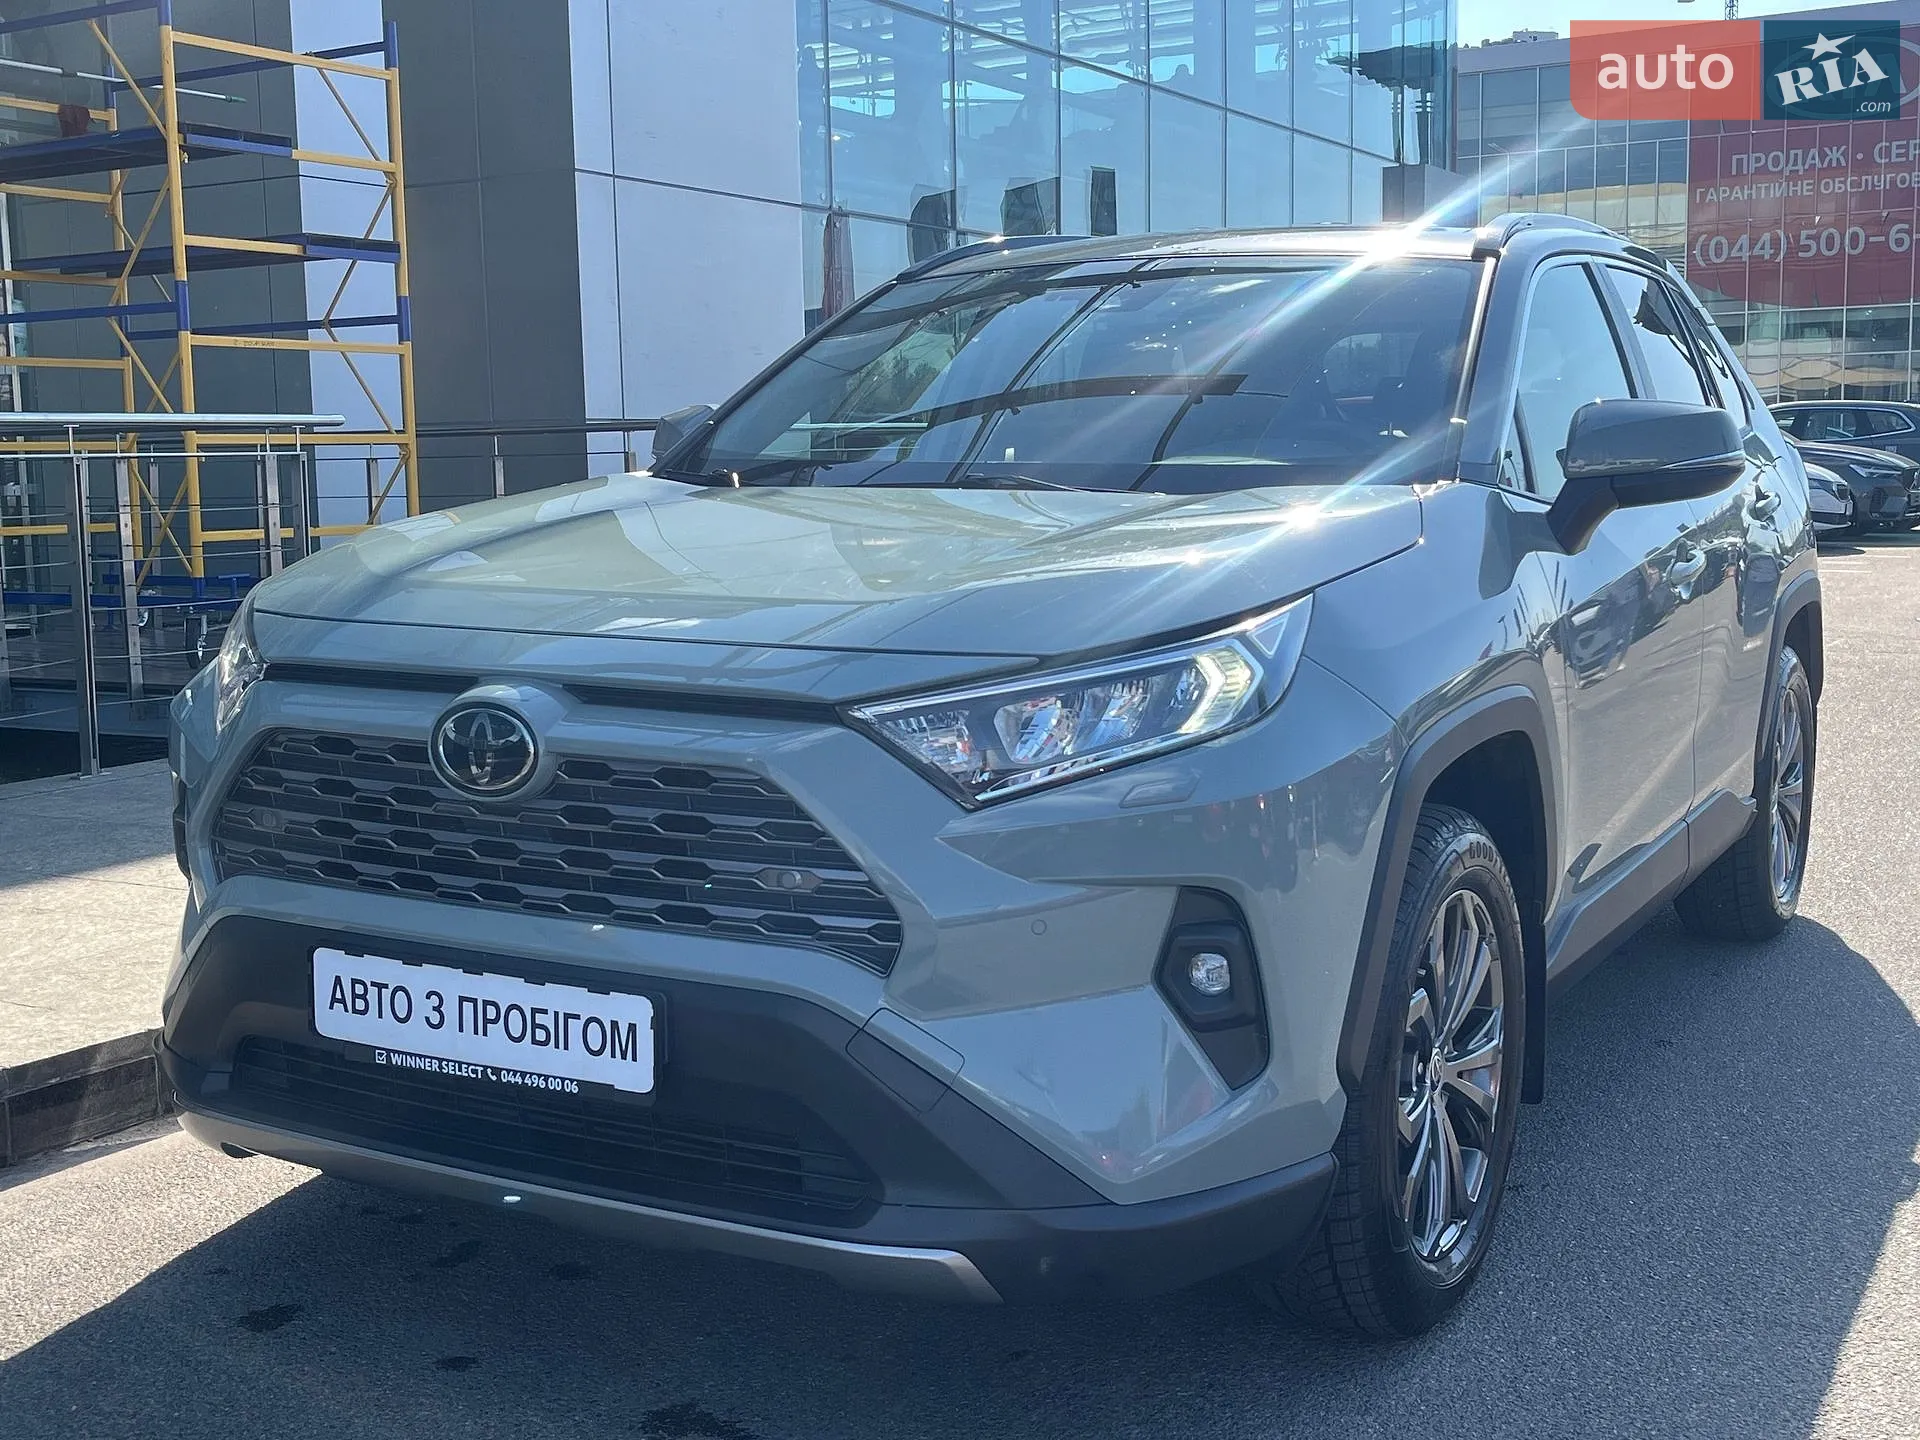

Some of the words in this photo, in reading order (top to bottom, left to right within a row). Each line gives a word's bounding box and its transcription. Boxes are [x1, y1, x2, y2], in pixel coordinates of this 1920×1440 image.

[1731, 145, 1848, 175] ПРОДАЖ
[1695, 178, 1814, 204] ГАРАНТІЙНЕ
[1695, 229, 1787, 267] (044)
[328, 975, 413, 1024] АВТО
[457, 995, 637, 1062] ПРОБІГОМ
[390, 1053, 440, 1072] WINNER
[441, 1060, 483, 1079] SELECT
[500, 1070, 523, 1084] 044
[524, 1074, 546, 1089] 496
[548, 1077, 562, 1091] 00
[564, 1079, 579, 1093] 06
